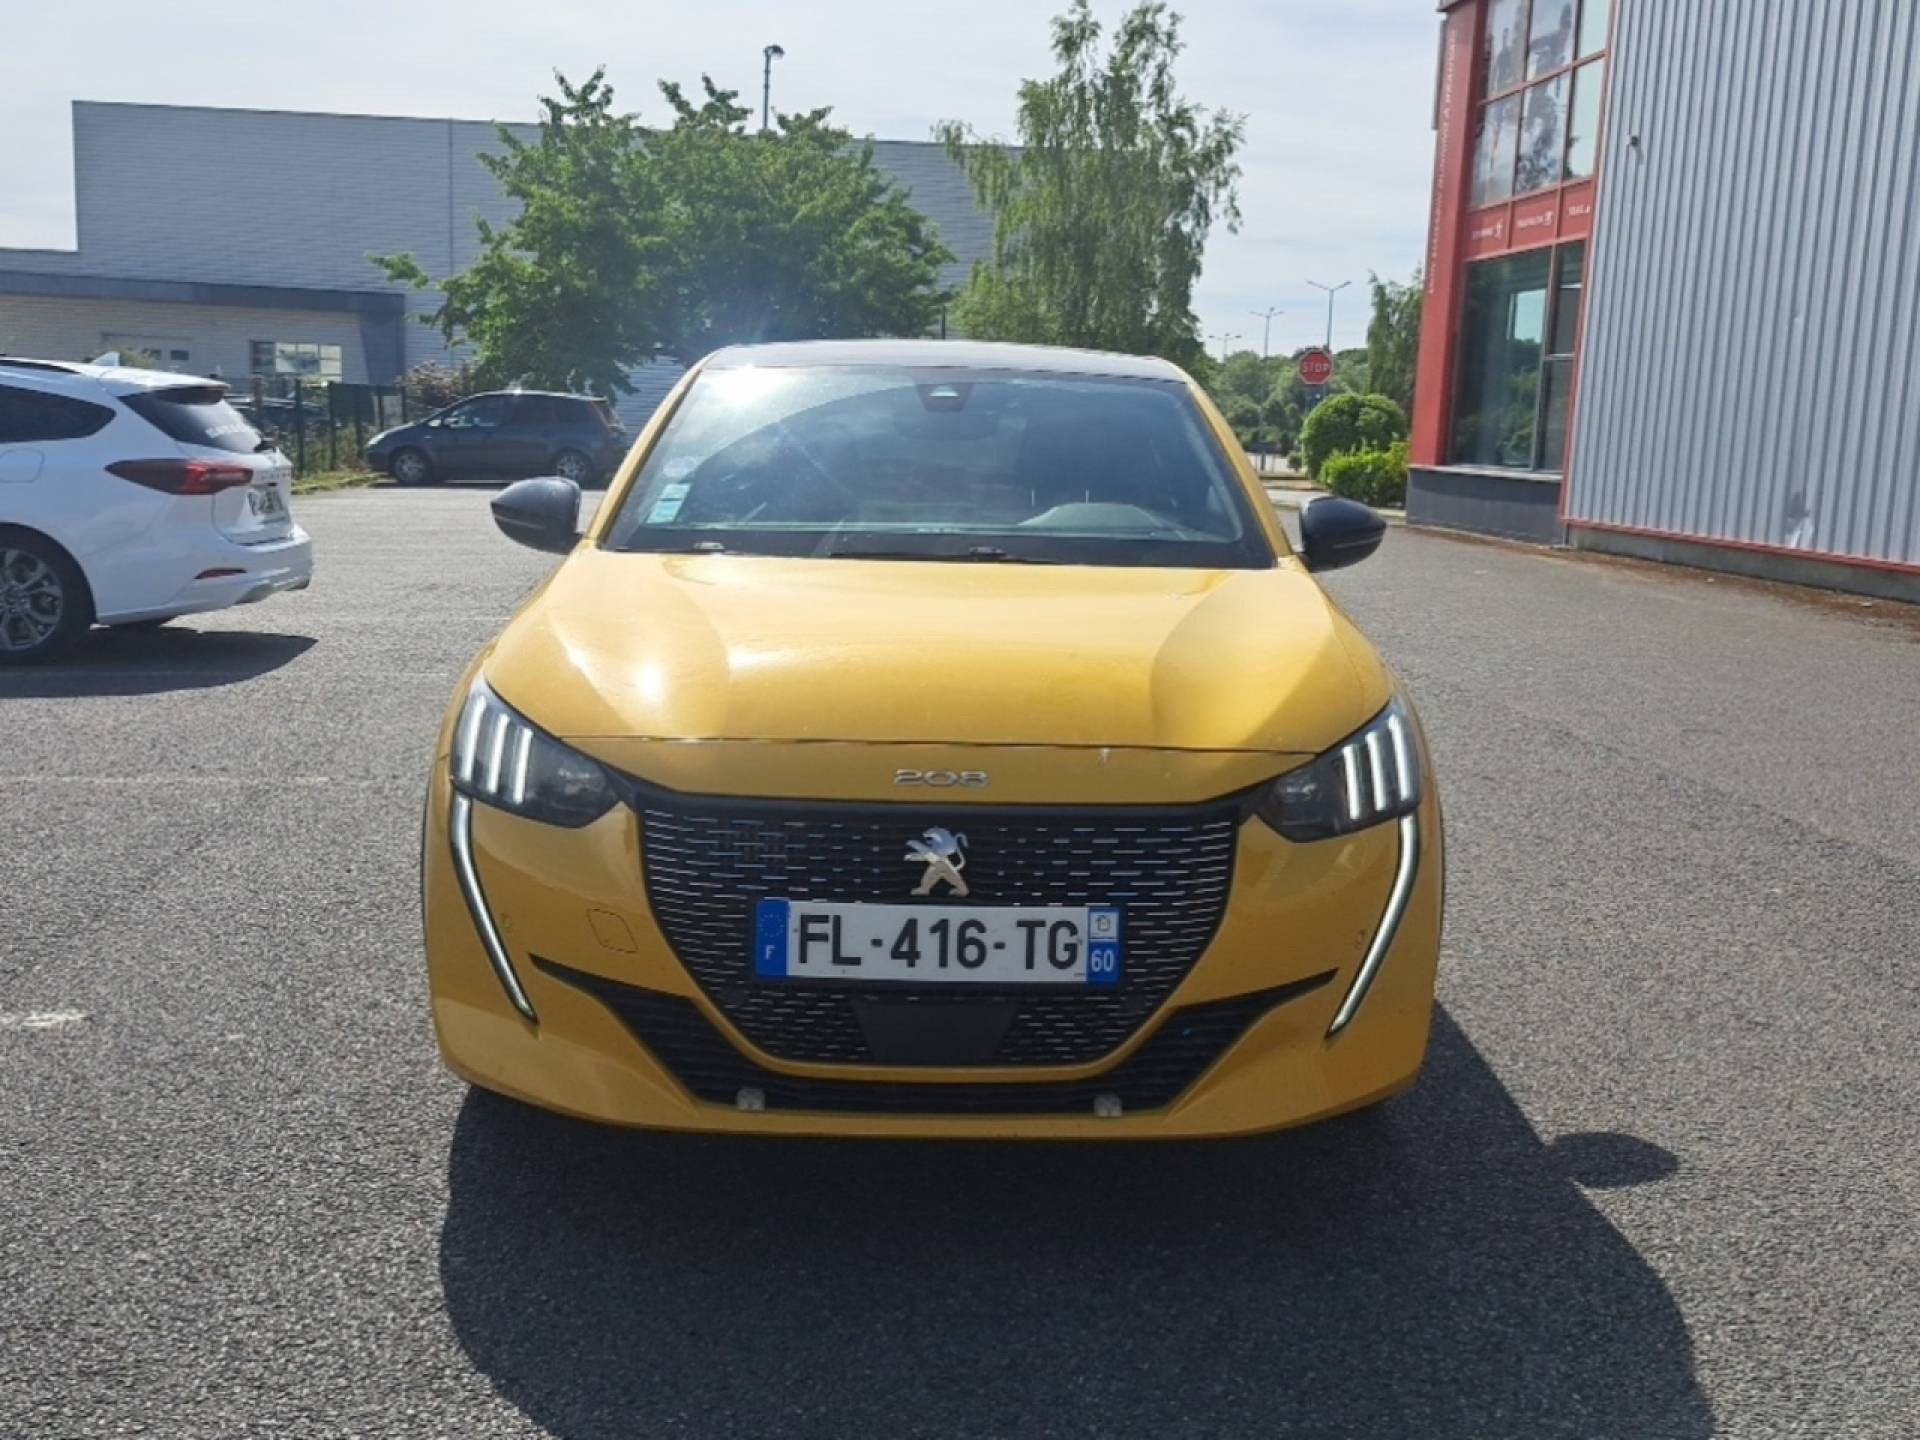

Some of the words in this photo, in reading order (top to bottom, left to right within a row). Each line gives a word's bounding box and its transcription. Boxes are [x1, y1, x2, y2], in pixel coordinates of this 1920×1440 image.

[1302, 361, 1329, 373] STOP
[893, 768, 989, 788] 208
[799, 913, 1079, 970] FL-416-TG
[765, 944, 777, 960] F
[1091, 949, 1114, 972] 60
